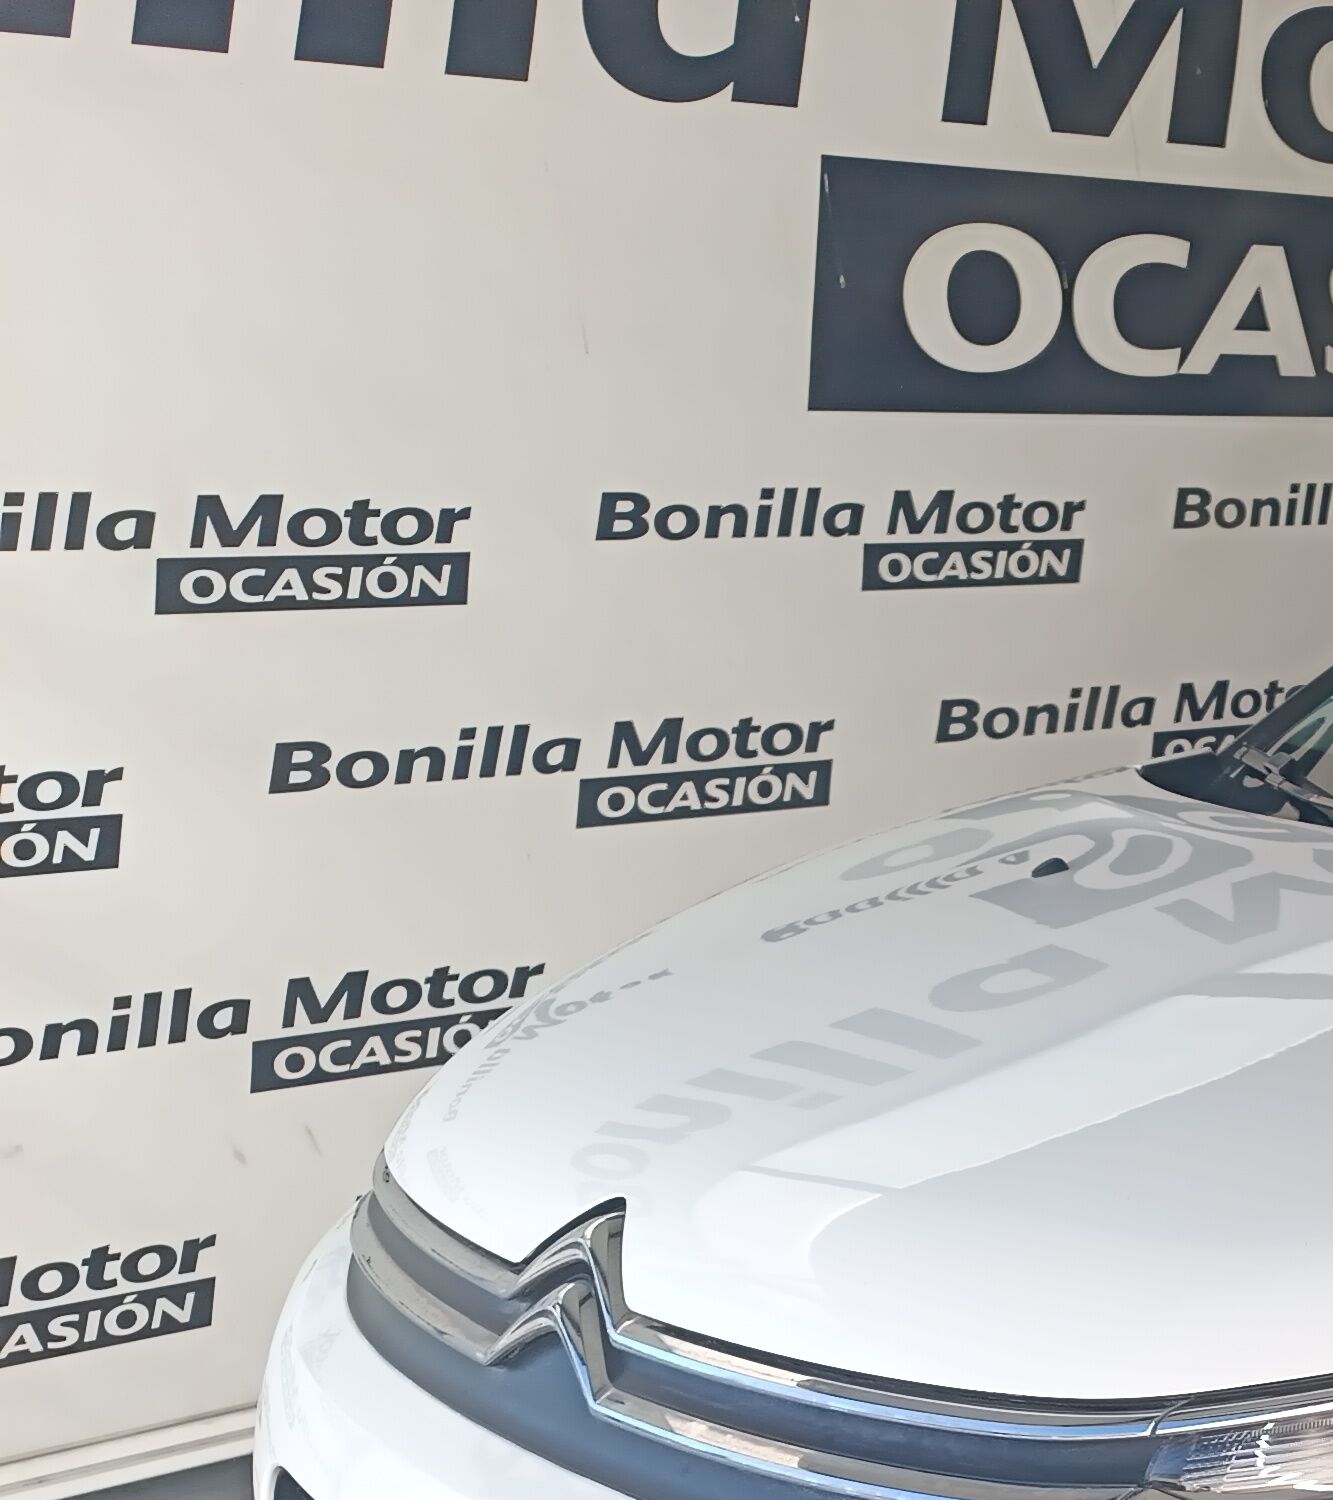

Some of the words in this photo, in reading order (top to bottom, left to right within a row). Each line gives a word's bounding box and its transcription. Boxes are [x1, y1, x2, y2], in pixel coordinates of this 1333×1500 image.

[190, 494, 471, 549] Motor
[595, 487, 865, 541] Bonilla
[887, 489, 1086, 535] Motor
[179, 556, 452, 605] OCASIÓN
[878, 542, 1072, 583] OCASIÓN
[935, 685, 1157, 744] Bonilla
[268, 723, 582, 794] Bonilla
[607, 716, 835, 768] Motor
[597, 767, 818, 818] OCASIÓN
[282, 963, 546, 1029] Motor
[273, 1016, 488, 1081] OCASIÓ
